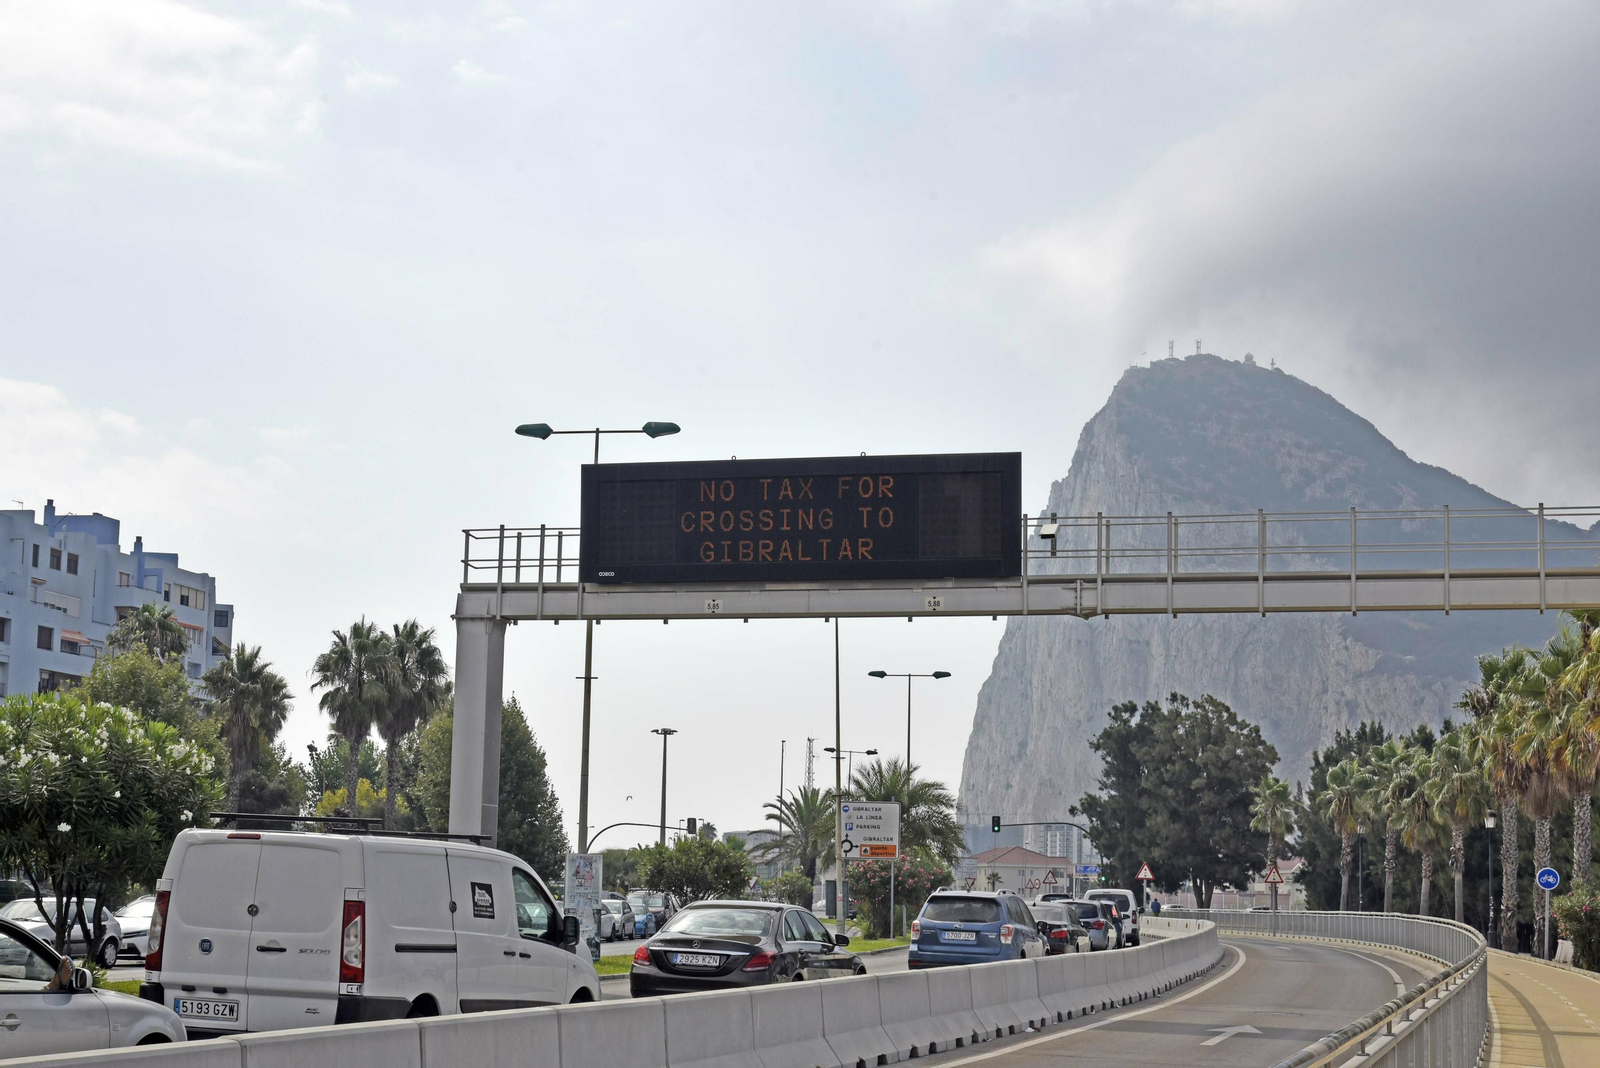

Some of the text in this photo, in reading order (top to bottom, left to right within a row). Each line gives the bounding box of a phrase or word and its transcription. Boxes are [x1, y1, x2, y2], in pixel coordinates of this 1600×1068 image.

[701, 475, 894, 502] NO TAX FOR
[681, 506, 894, 533] CROSSING TO
[700, 537, 874, 563] GIBRALTAR
[927, 600, 941, 608] 5,88
[679, 955, 718, 965] 2925 KZN
[181, 1001, 236, 1017] 5193 GZW
